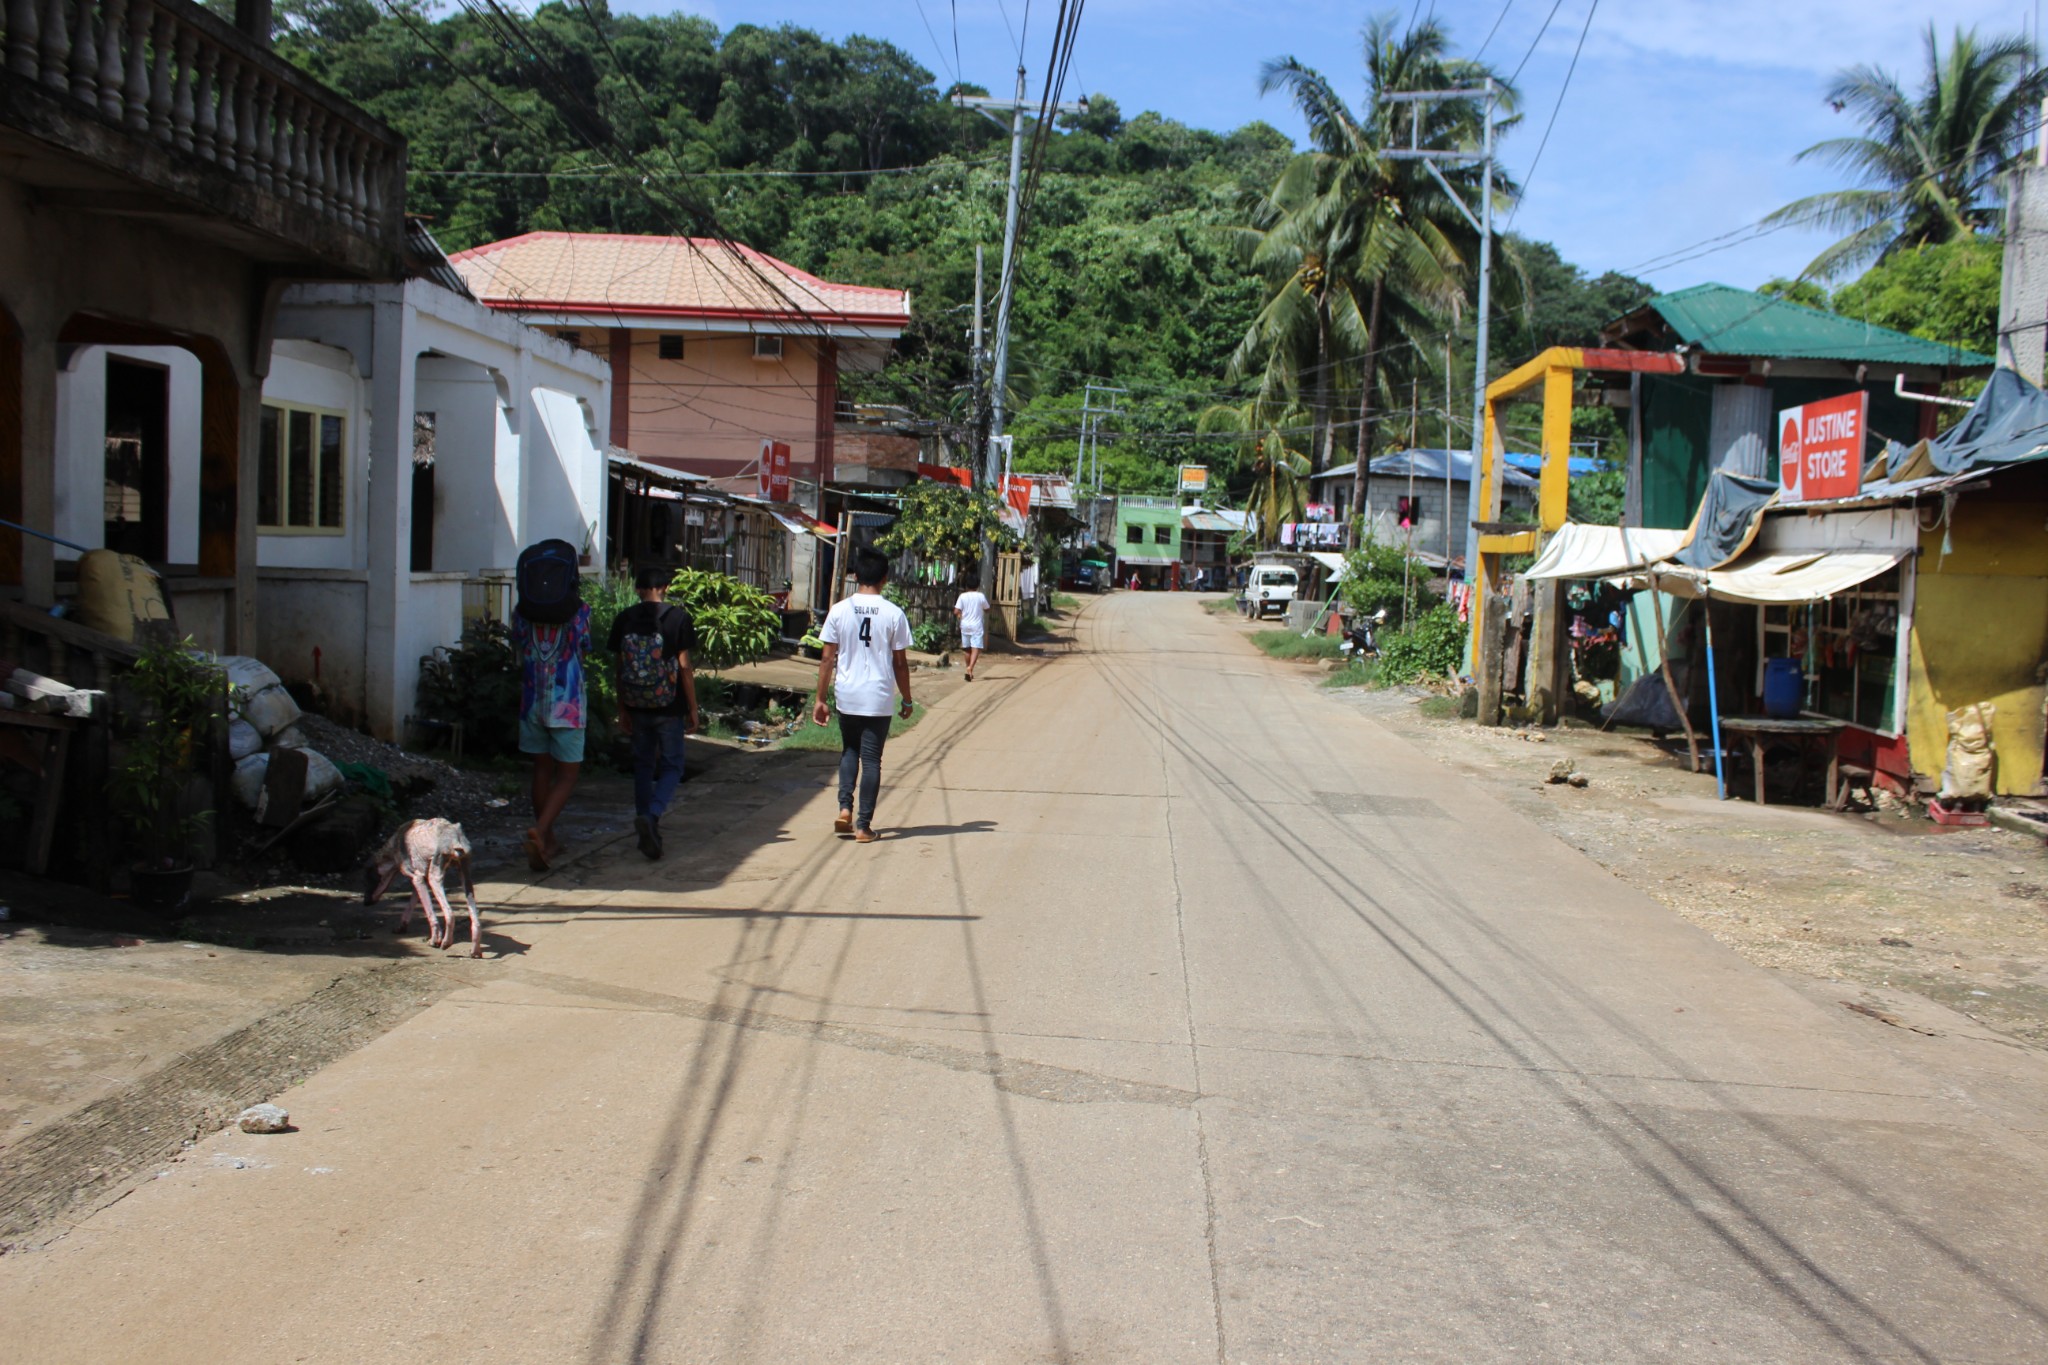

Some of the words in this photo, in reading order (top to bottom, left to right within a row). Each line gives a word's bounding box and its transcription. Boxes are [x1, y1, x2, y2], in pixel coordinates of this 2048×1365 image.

[1805, 409, 1856, 445] JUSTINE
[1807, 449, 1847, 480] STORE
[859, 617, 871, 648] 4
